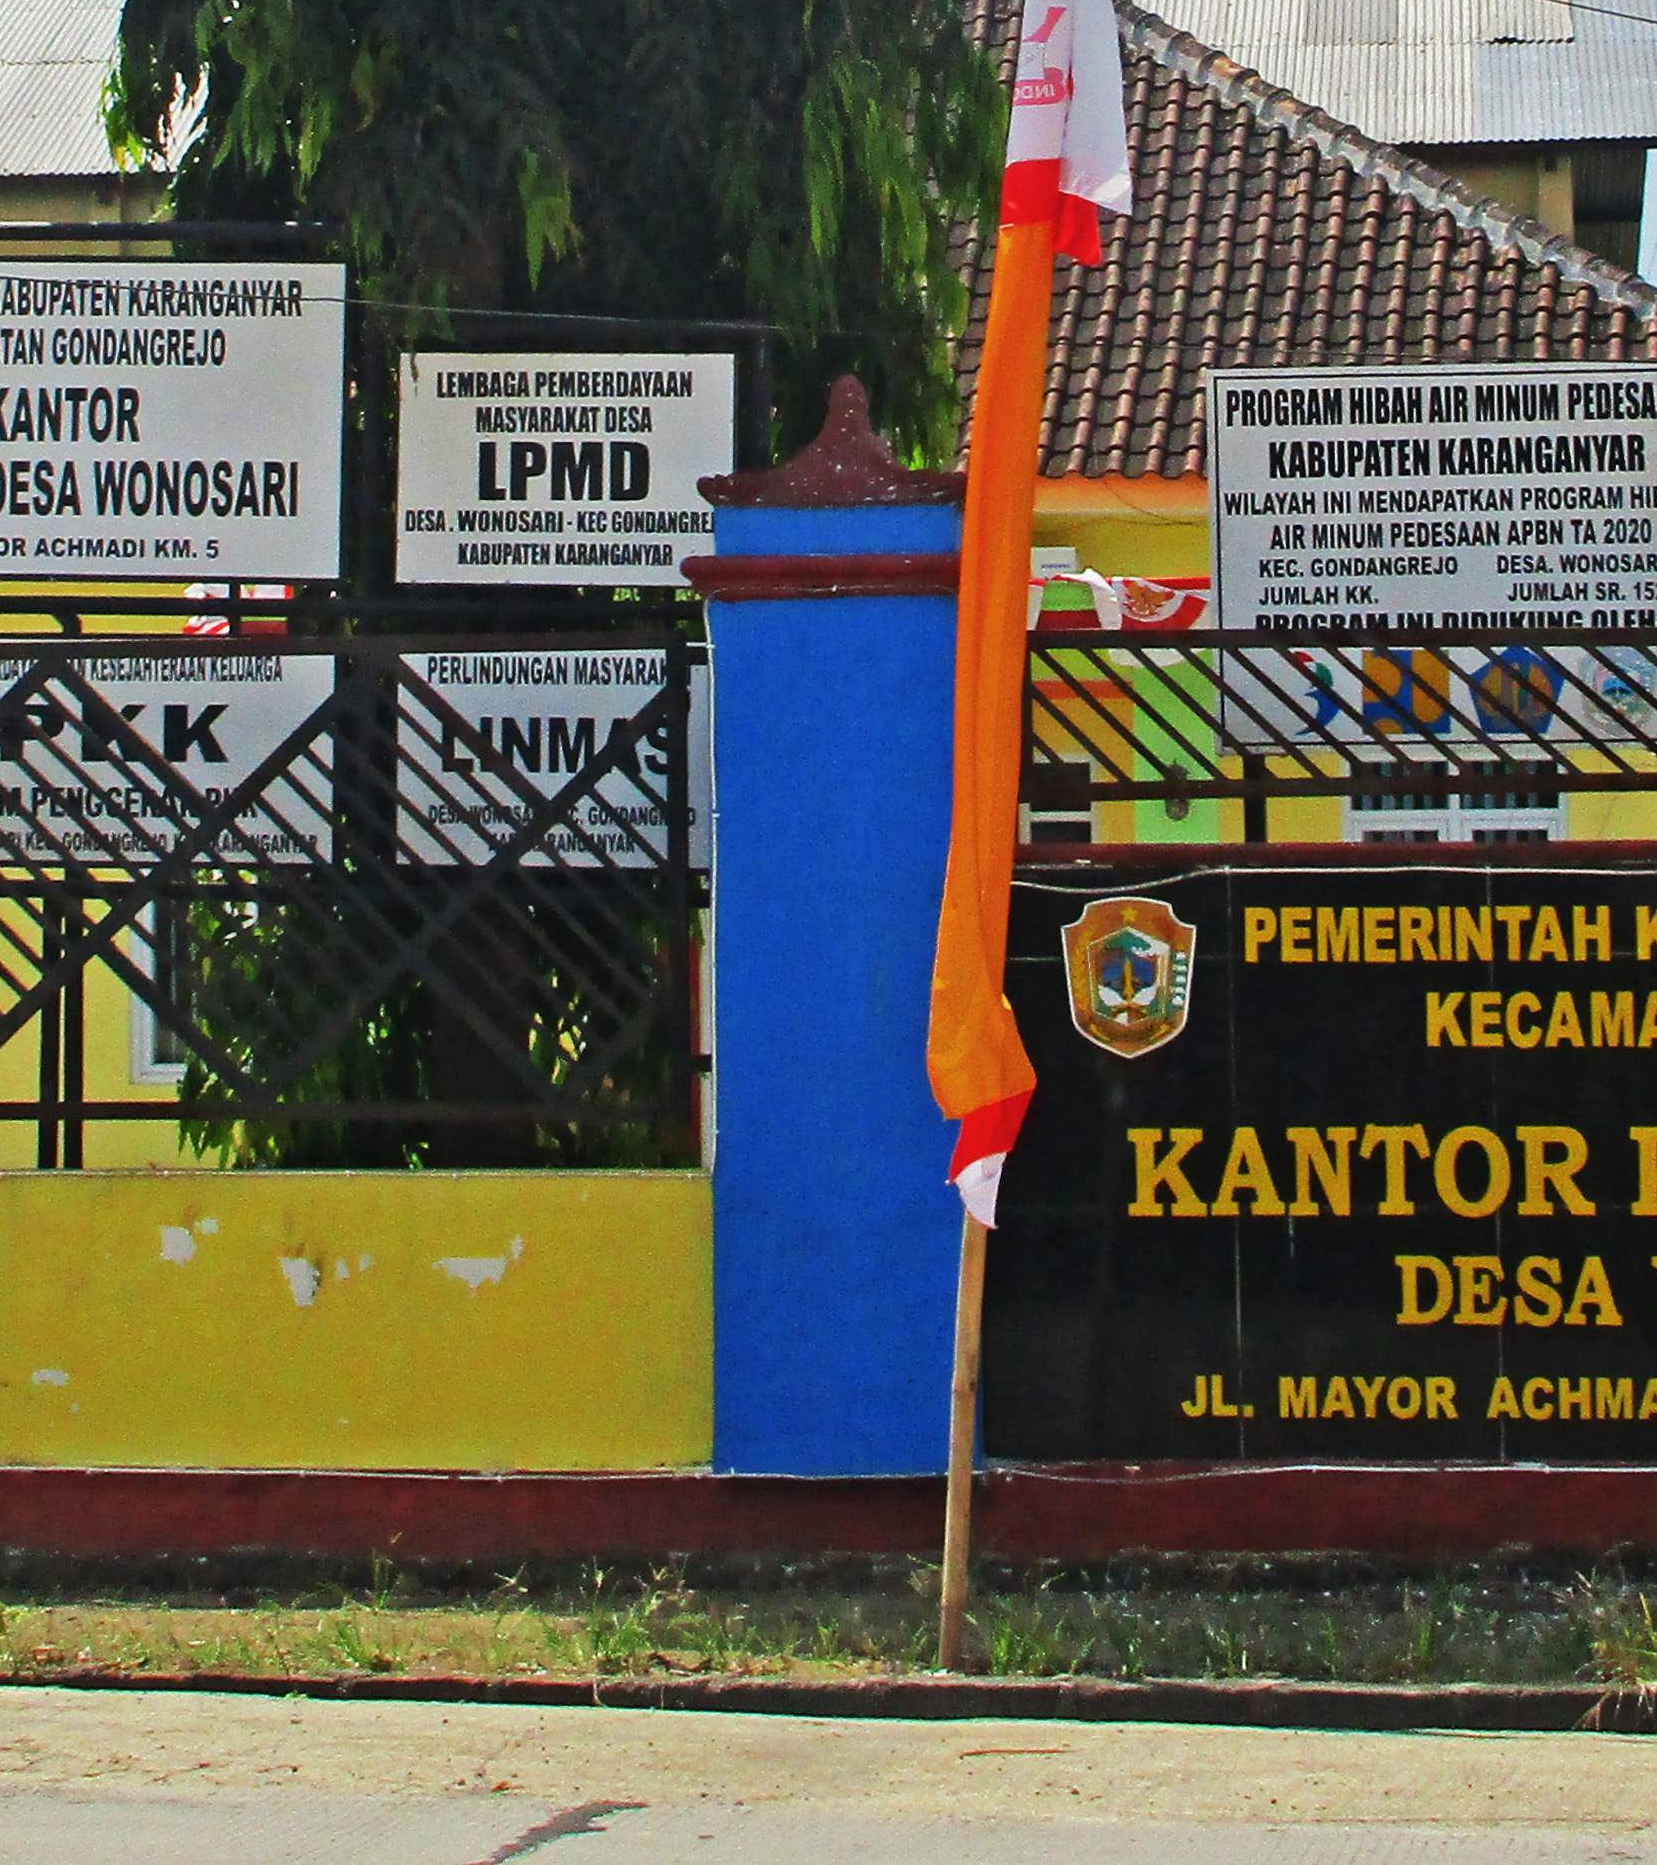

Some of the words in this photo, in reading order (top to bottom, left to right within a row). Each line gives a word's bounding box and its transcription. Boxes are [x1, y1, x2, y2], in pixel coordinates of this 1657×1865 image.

[128, 279, 302, 317] KARANGANYAR
[52, 329, 226, 366] GONDANGREJO
[437, 371, 530, 398] LEMBAGA
[535, 371, 693, 398] PEMBERDAYAAN
[476, 406, 601, 433] MASYARAKAT
[605, 406, 653, 433] DESA
[1226, 388, 1342, 427] PROGRAM
[1349, 385, 1424, 424] HIBAH
[1429, 385, 1469, 423] AIR
[1475, 383, 1559, 422] MINUM
[478, 441, 651, 501] LPMD
[1269, 439, 1431, 479] KABUPATEN
[1439, 435, 1646, 476] KARANGANYAR
[94, 460, 299, 517] WONOSARI
[1224, 492, 1315, 516] WILAYAH
[1323, 491, 1351, 515] INI
[1358, 488, 1514, 514] MENDAPATKAN
[1521, 486, 1623, 511] PROGRAM
[458, 510, 563, 533] WONOSARI
[577, 511, 607, 533] KEC
[612, 511, 715, 534] GONDANGREJ
[1271, 525, 1306, 550] AIR
[1312, 523, 1383, 548] MINUM
[1390, 520, 1500, 548] PEDESAAN
[1507, 519, 1564, 546] APBN
[1570, 519, 1596, 544] TA
[1603, 518, 1652, 544] 2020
[34, 537, 145, 559] ACHMADI
[154, 538, 197, 559] KM.
[206, 540, 219, 559] 5
[458, 543, 550, 566] KABUPATEN
[555, 544, 673, 566] KARANGANYAR
[1259, 558, 1304, 578] KEC.
[1310, 555, 1459, 577] GONDANGREJO
[1497, 554, 1553, 574] DESA.
[1259, 586, 1339, 606] JUMLAH
[1345, 585, 1379, 605] KK.
[1508, 582, 1589, 603] JUMLAH
[1595, 582, 1626, 602] SR.
[210, 656, 282, 682] KELUARGA
[428, 657, 568, 685] PERLINDUNGAN
[574, 656, 667, 685] MASYARA
[1244, 906, 1611, 964] PEMERINTAH
[1126, 1122, 1598, 1219] KANTOR
[1395, 1255, 1624, 1327] DESA
[1181, 1374, 1254, 1419] JL.
[1279, 1375, 1459, 1420] MAYOR
